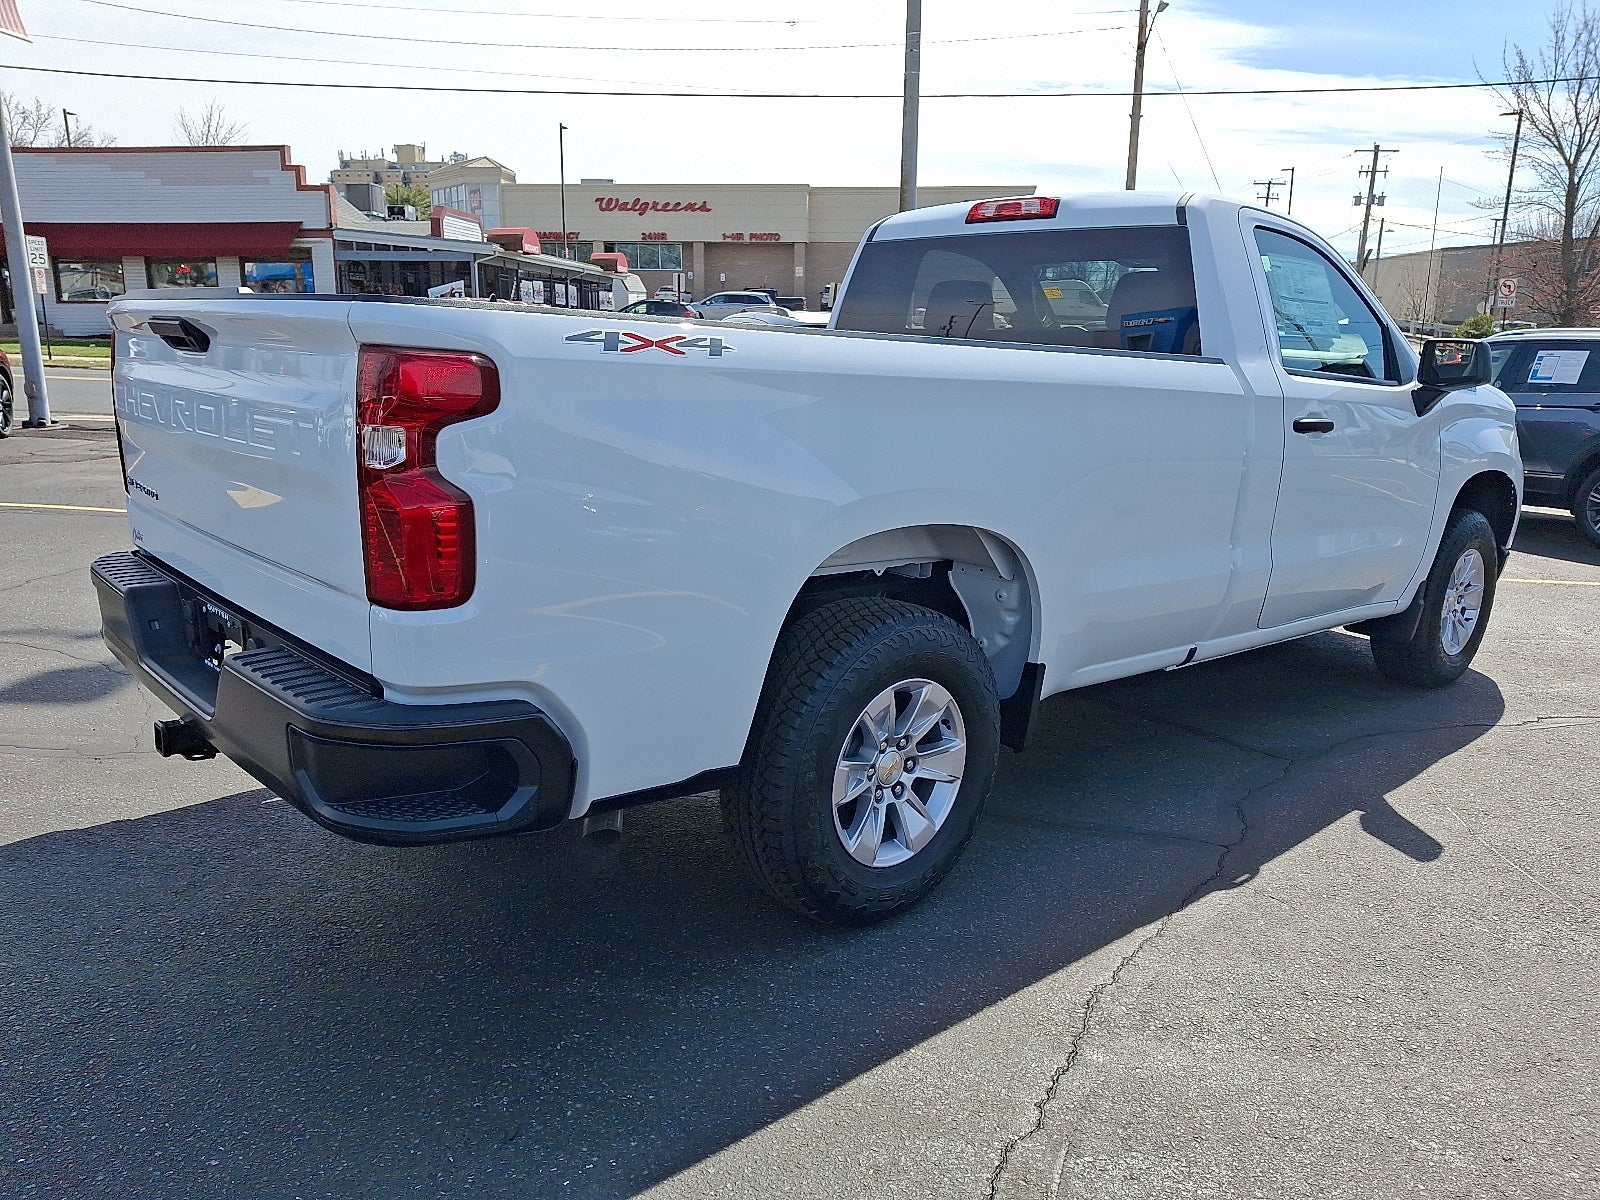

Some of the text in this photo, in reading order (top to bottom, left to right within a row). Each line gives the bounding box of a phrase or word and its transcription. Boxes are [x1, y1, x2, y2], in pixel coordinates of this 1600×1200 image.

[595, 197, 712, 216] Walgreens
[722, 232, 781, 241] 1-HR PHOTO
[30, 253, 46, 264] 25
[115, 384, 315, 456] CHEVROLET
